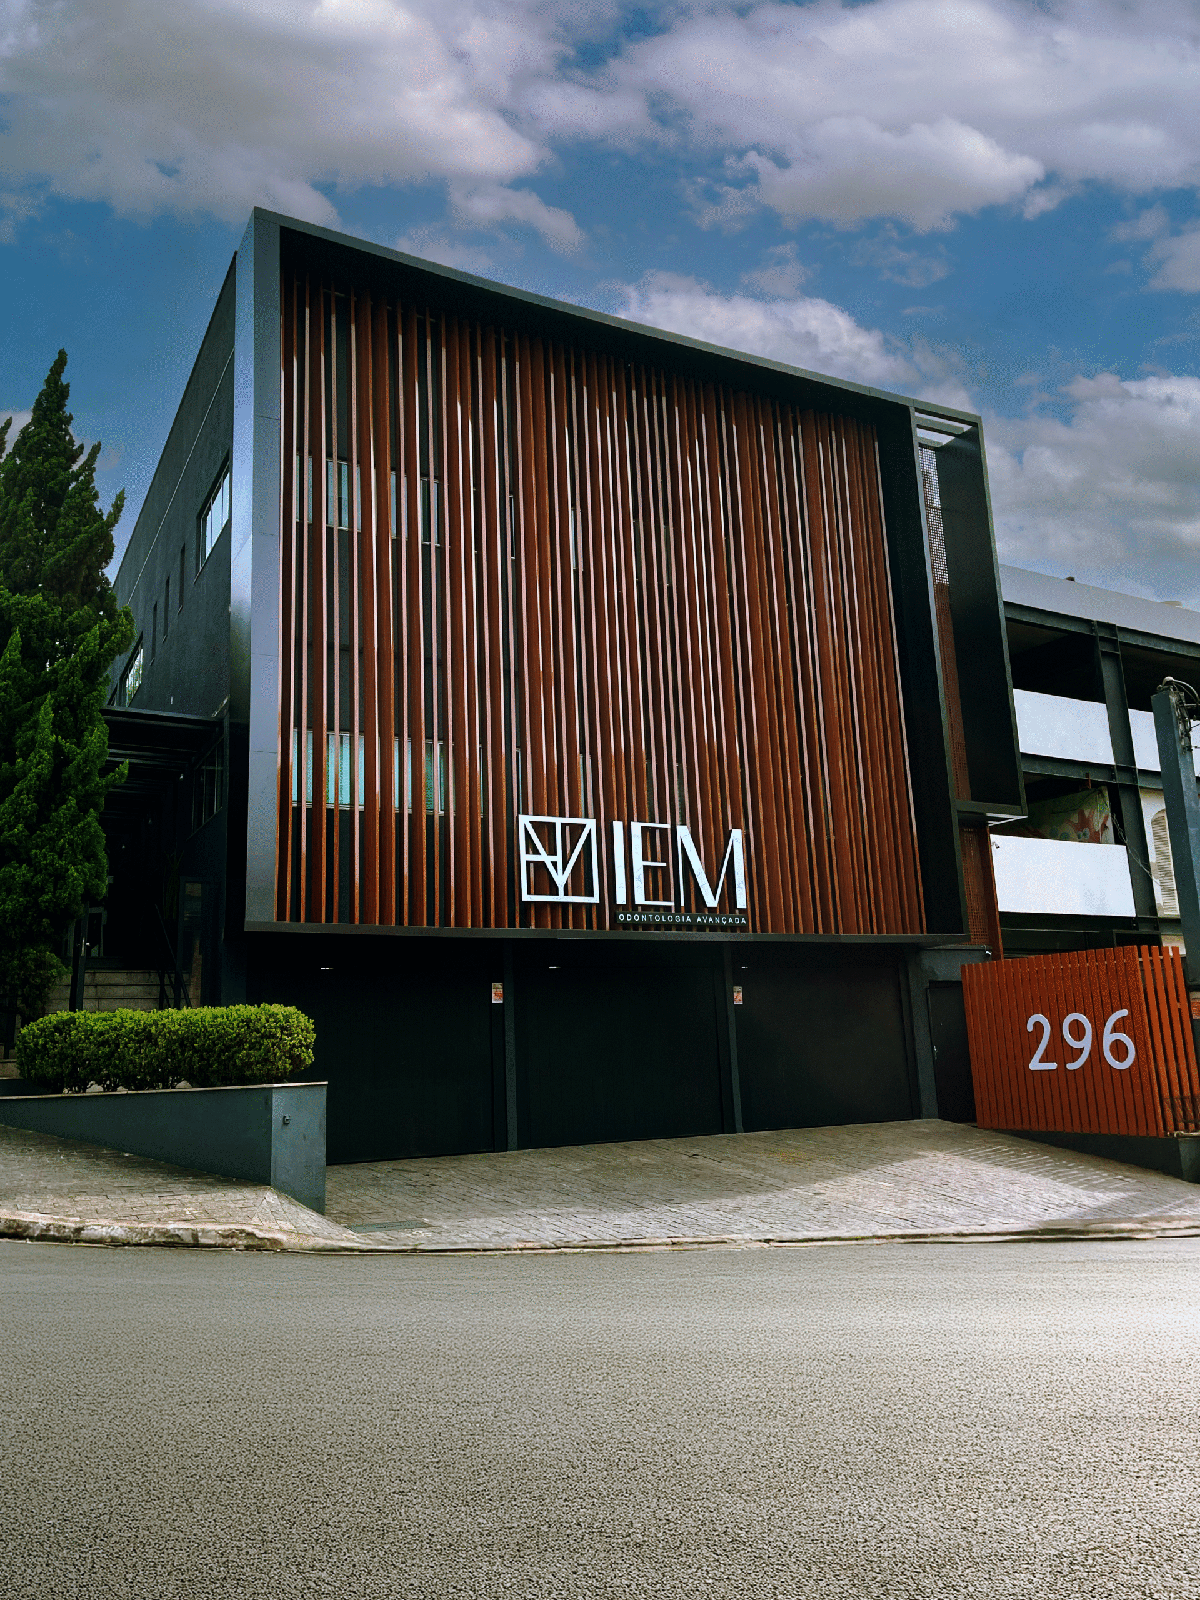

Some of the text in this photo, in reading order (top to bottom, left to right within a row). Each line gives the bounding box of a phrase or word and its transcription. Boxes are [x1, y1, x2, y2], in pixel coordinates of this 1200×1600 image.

[612, 820, 747, 908] IEM
[618, 913, 747, 925] ODONTOLOGIA AVANÇADA
[1026, 1008, 1135, 1070] 296
